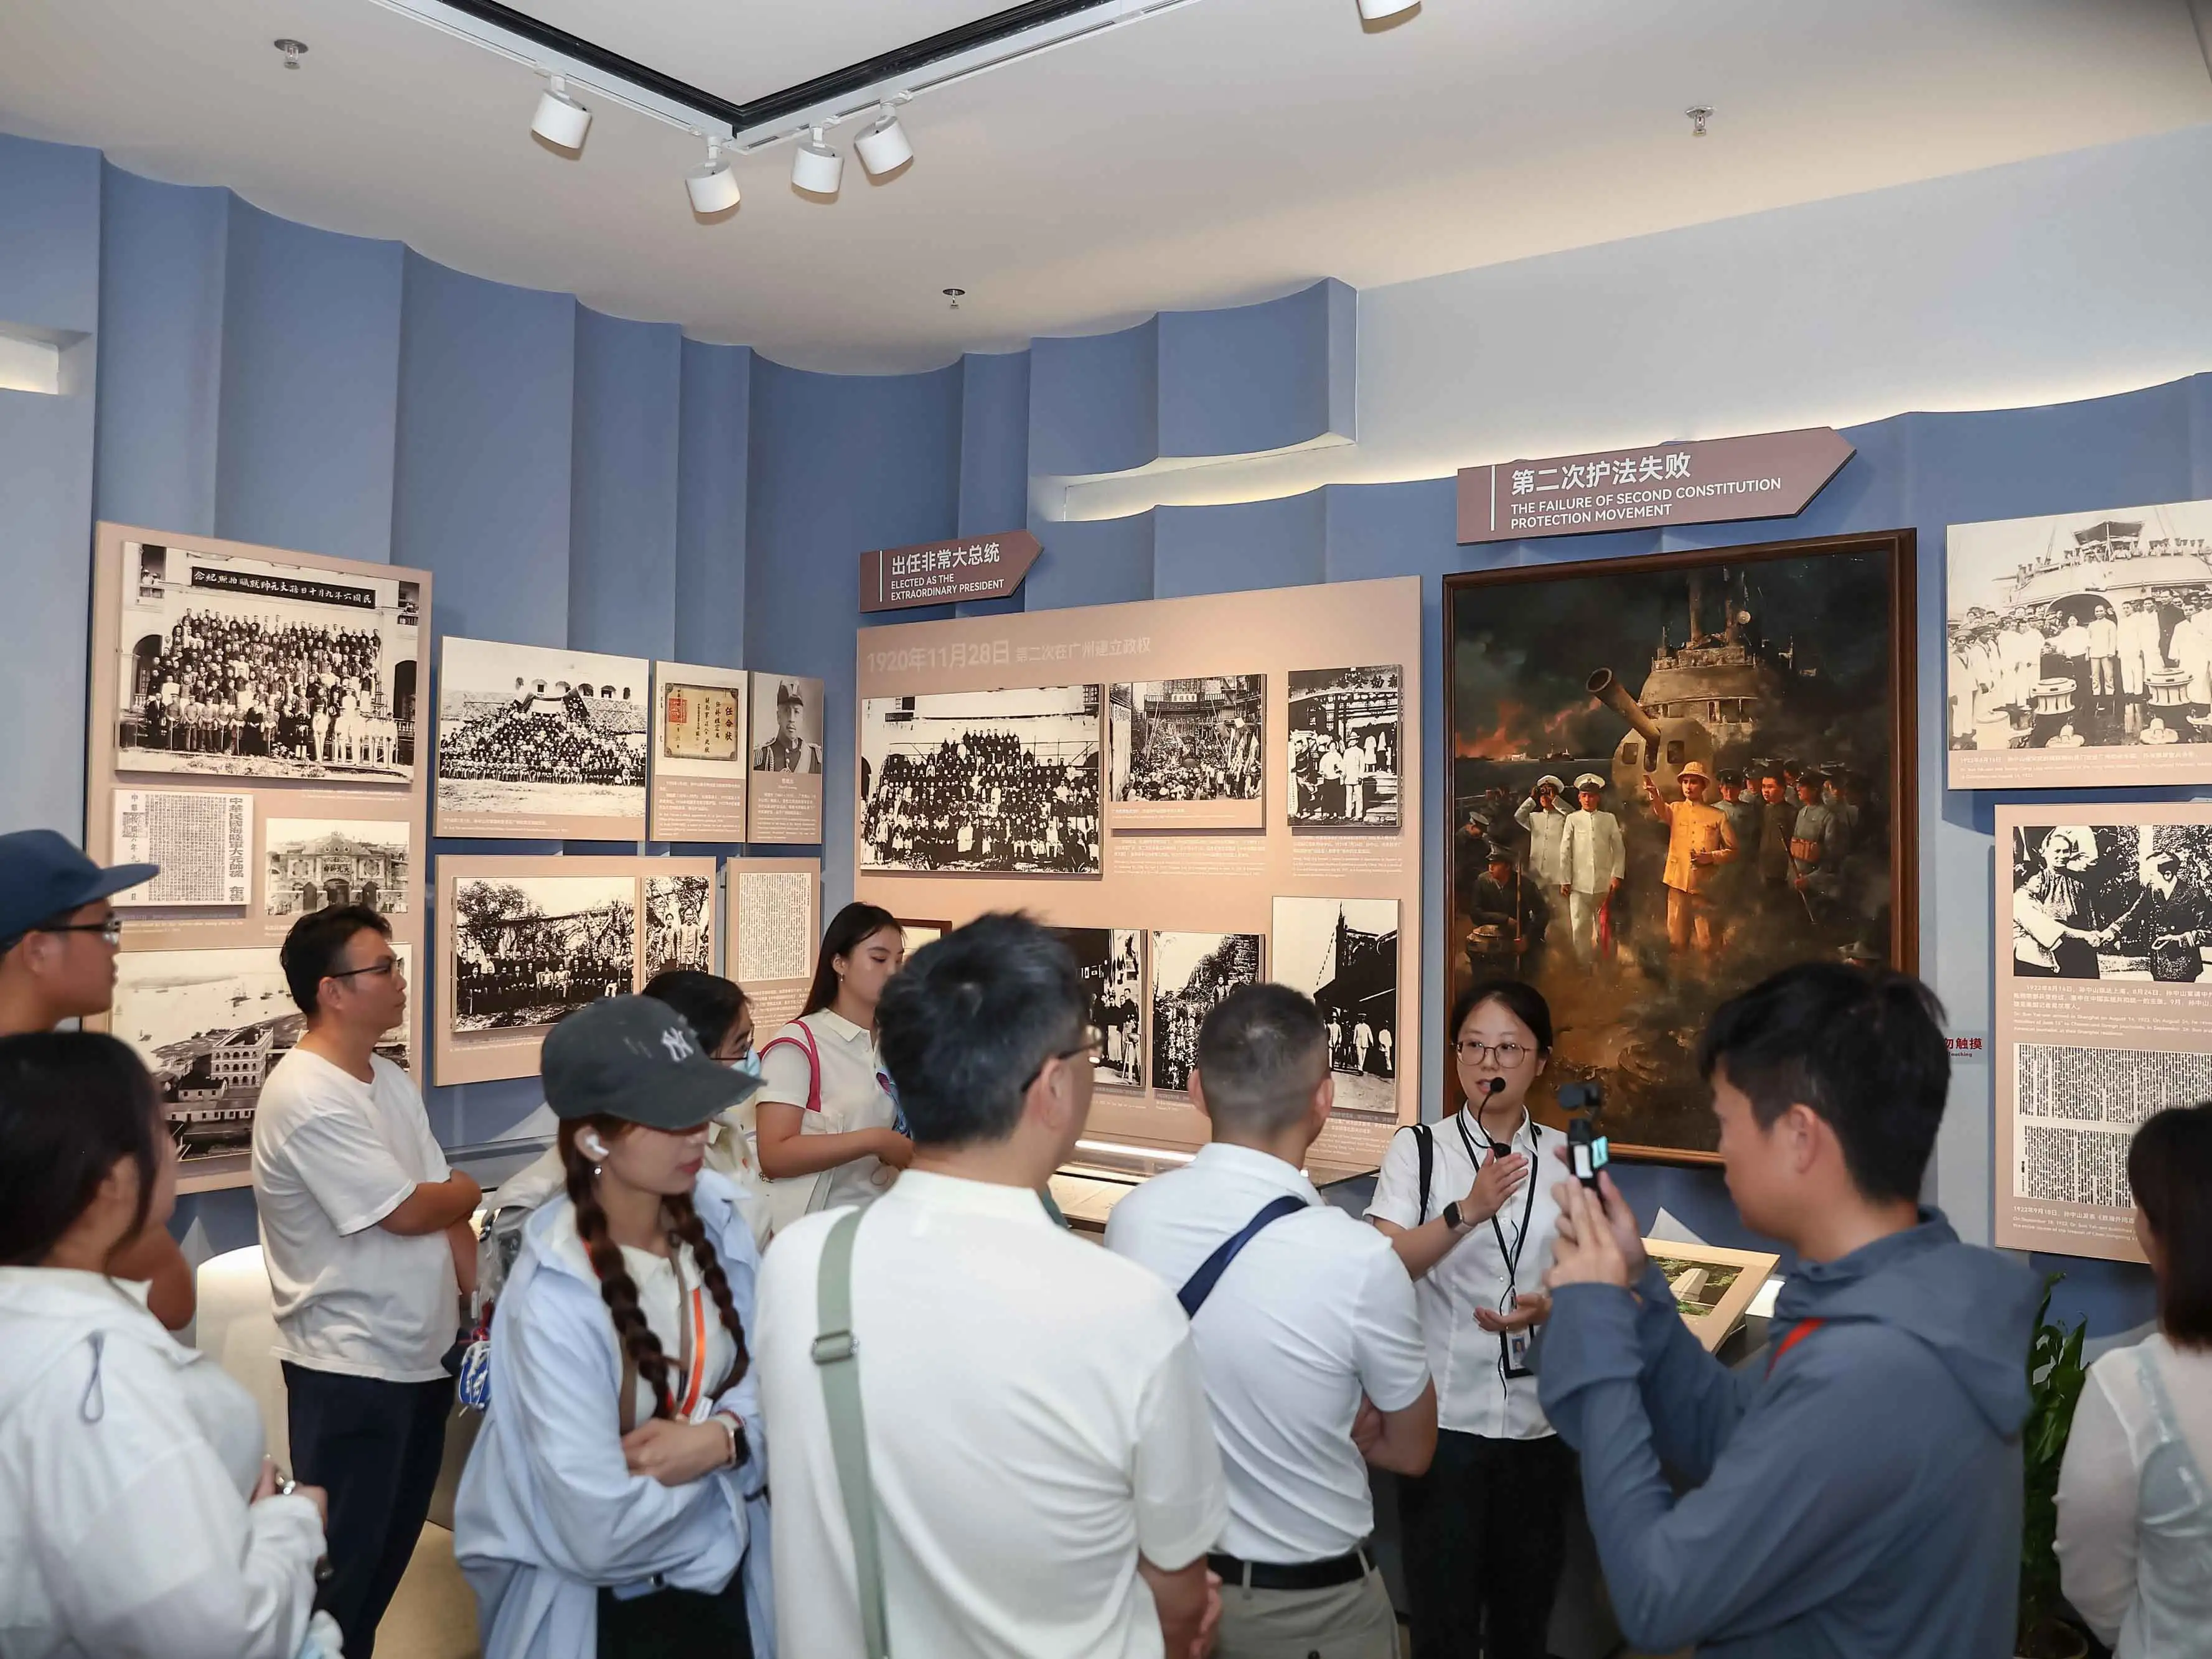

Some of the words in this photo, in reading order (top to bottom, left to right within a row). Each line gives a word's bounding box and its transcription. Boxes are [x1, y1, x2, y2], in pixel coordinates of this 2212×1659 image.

[1511, 452, 1690, 496] 第二次护法失败
[1511, 503, 1535, 515] THE
[1539, 497, 1590, 513] FAILURE
[1596, 494, 1613, 507] OF
[1617, 488, 1672, 505] SECOND
[1675, 478, 1781, 500] CONSTITUTION
[1511, 513, 1591, 530] PROTECTION
[1595, 504, 1672, 522] MOVEMENT
[891, 543, 1000, 576] 出任非常大总统
[891, 579, 924, 590] ELECTED
[927, 576, 937, 586] AS
[939, 574, 954, 584] THE
[891, 584, 957, 601] EXTRAORDINARY
[960, 579, 1004, 593] PRESIDENT
[867, 640, 1010, 673] 1920年11月28日
[1016, 637, 1150, 663] 第二次在广州建立政权
[661, 1027, 693, 1062] NY
[1944, 1037, 1982, 1049] 勿触摸
